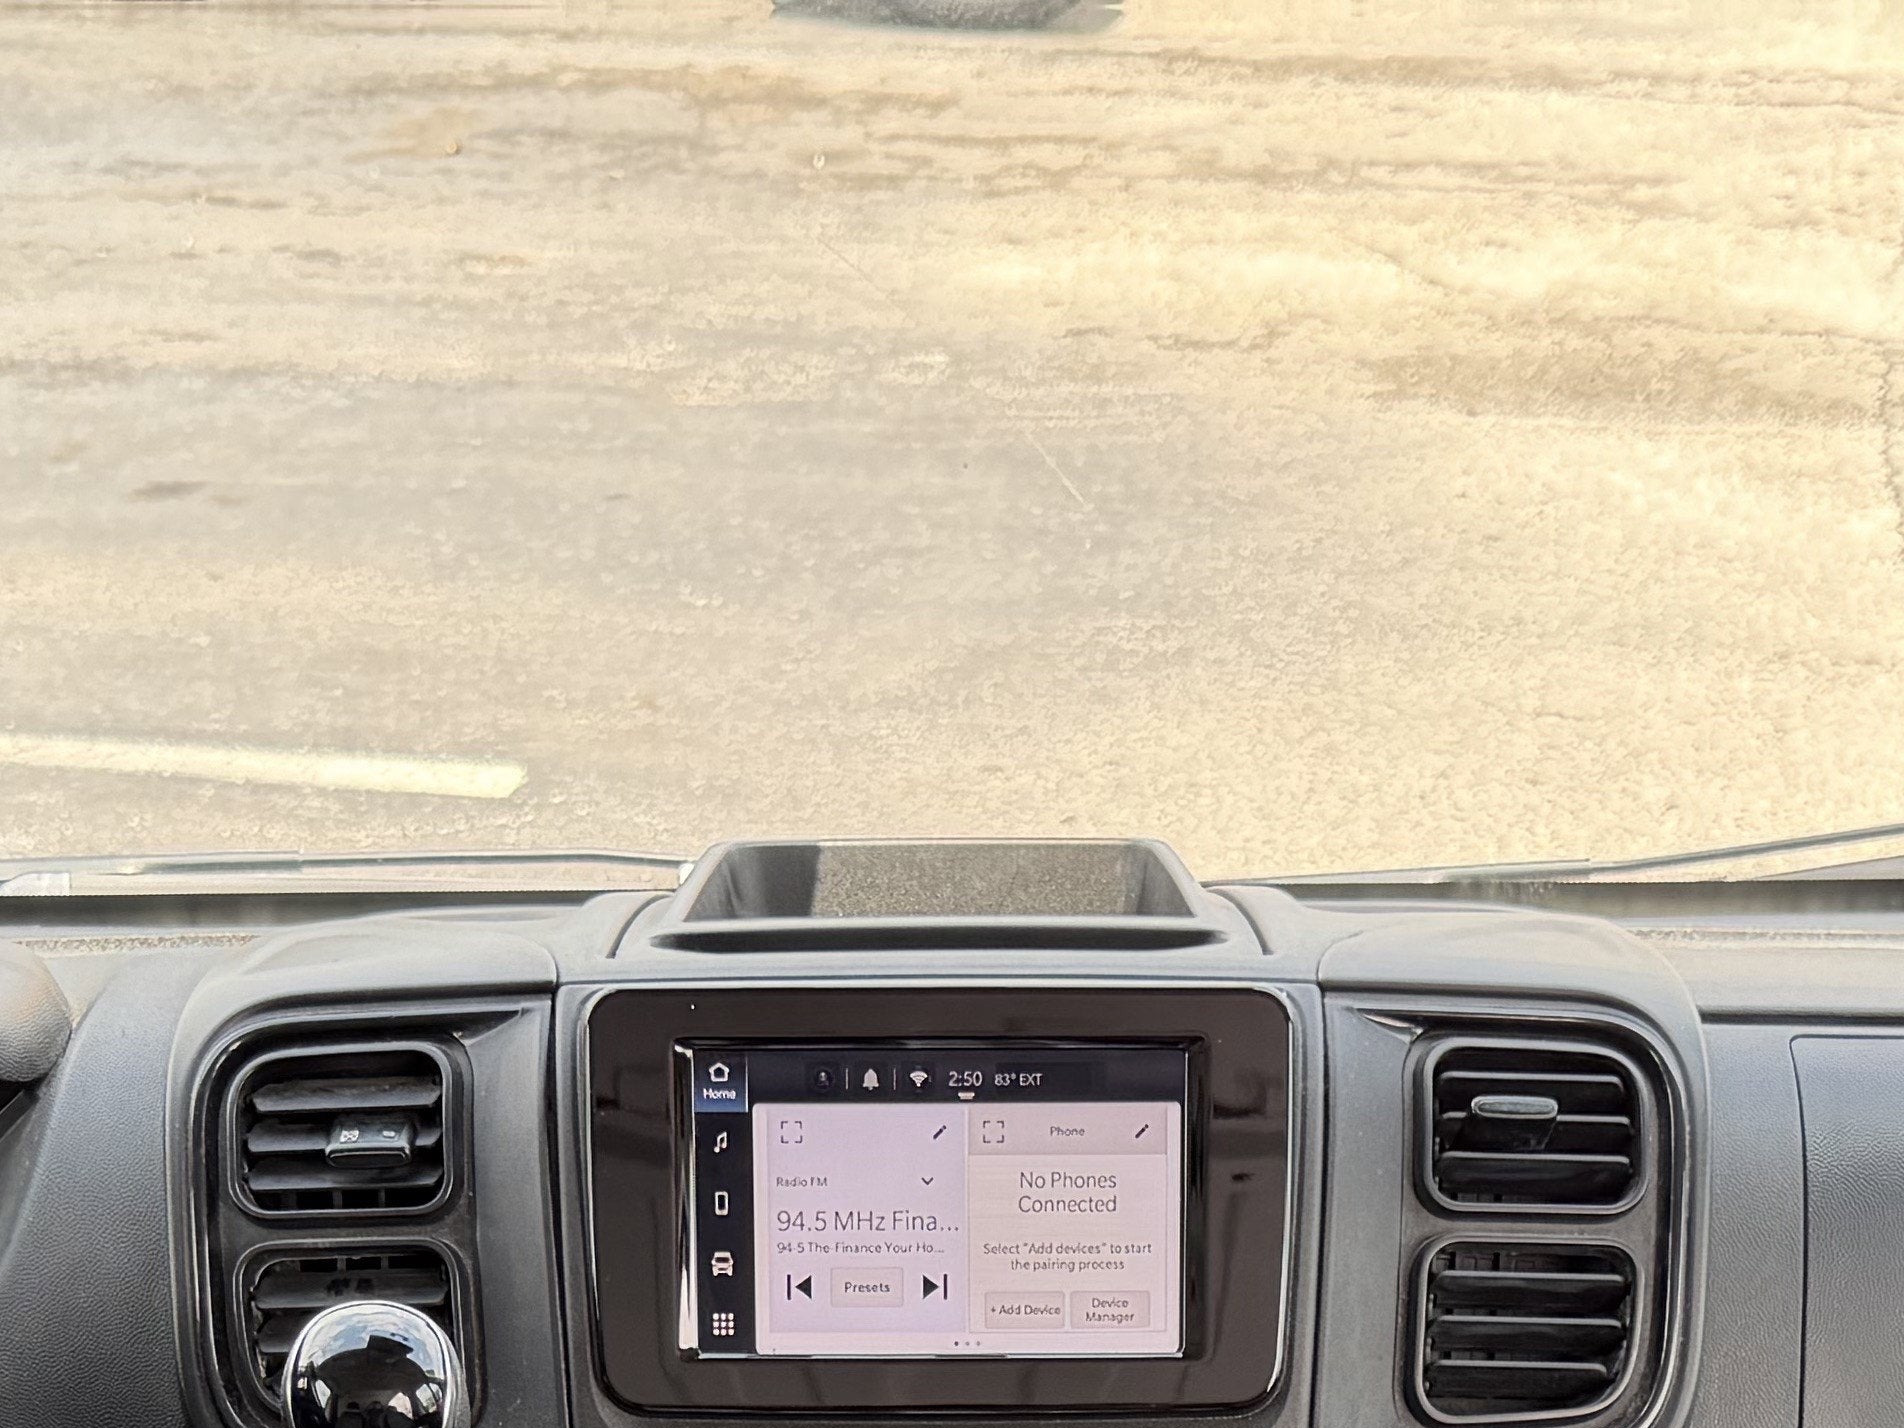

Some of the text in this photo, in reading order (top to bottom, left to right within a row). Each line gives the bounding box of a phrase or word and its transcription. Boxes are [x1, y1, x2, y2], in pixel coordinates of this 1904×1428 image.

[949, 1071, 983, 1087] 2:50
[1019, 1074, 1043, 1086] EXT
[703, 1088, 736, 1100] Home
[1049, 1126, 1086, 1137] Phone
[776, 1176, 808, 1187] Radio
[1019, 1172, 1117, 1189] No Phones
[1018, 1195, 1117, 1213] Connected
[776, 1210, 827, 1232] 94.5
[834, 1210, 886, 1232] MHz
[808, 1241, 829, 1253] The
[835, 1241, 882, 1253] Finance
[884, 1241, 912, 1253] Your
[984, 1243, 1020, 1255] Select
[1110, 1243, 1121, 1254] to
[1124, 1243, 1152, 1255] start
[1011, 1259, 1125, 1273] the pairing process
[844, 1282, 890, 1294] Presets
[999, 1304, 1021, 1315] Add
[1024, 1304, 1061, 1315] Device
[1092, 1298, 1129, 1309] Device
[1085, 1311, 1135, 1324] Manager
